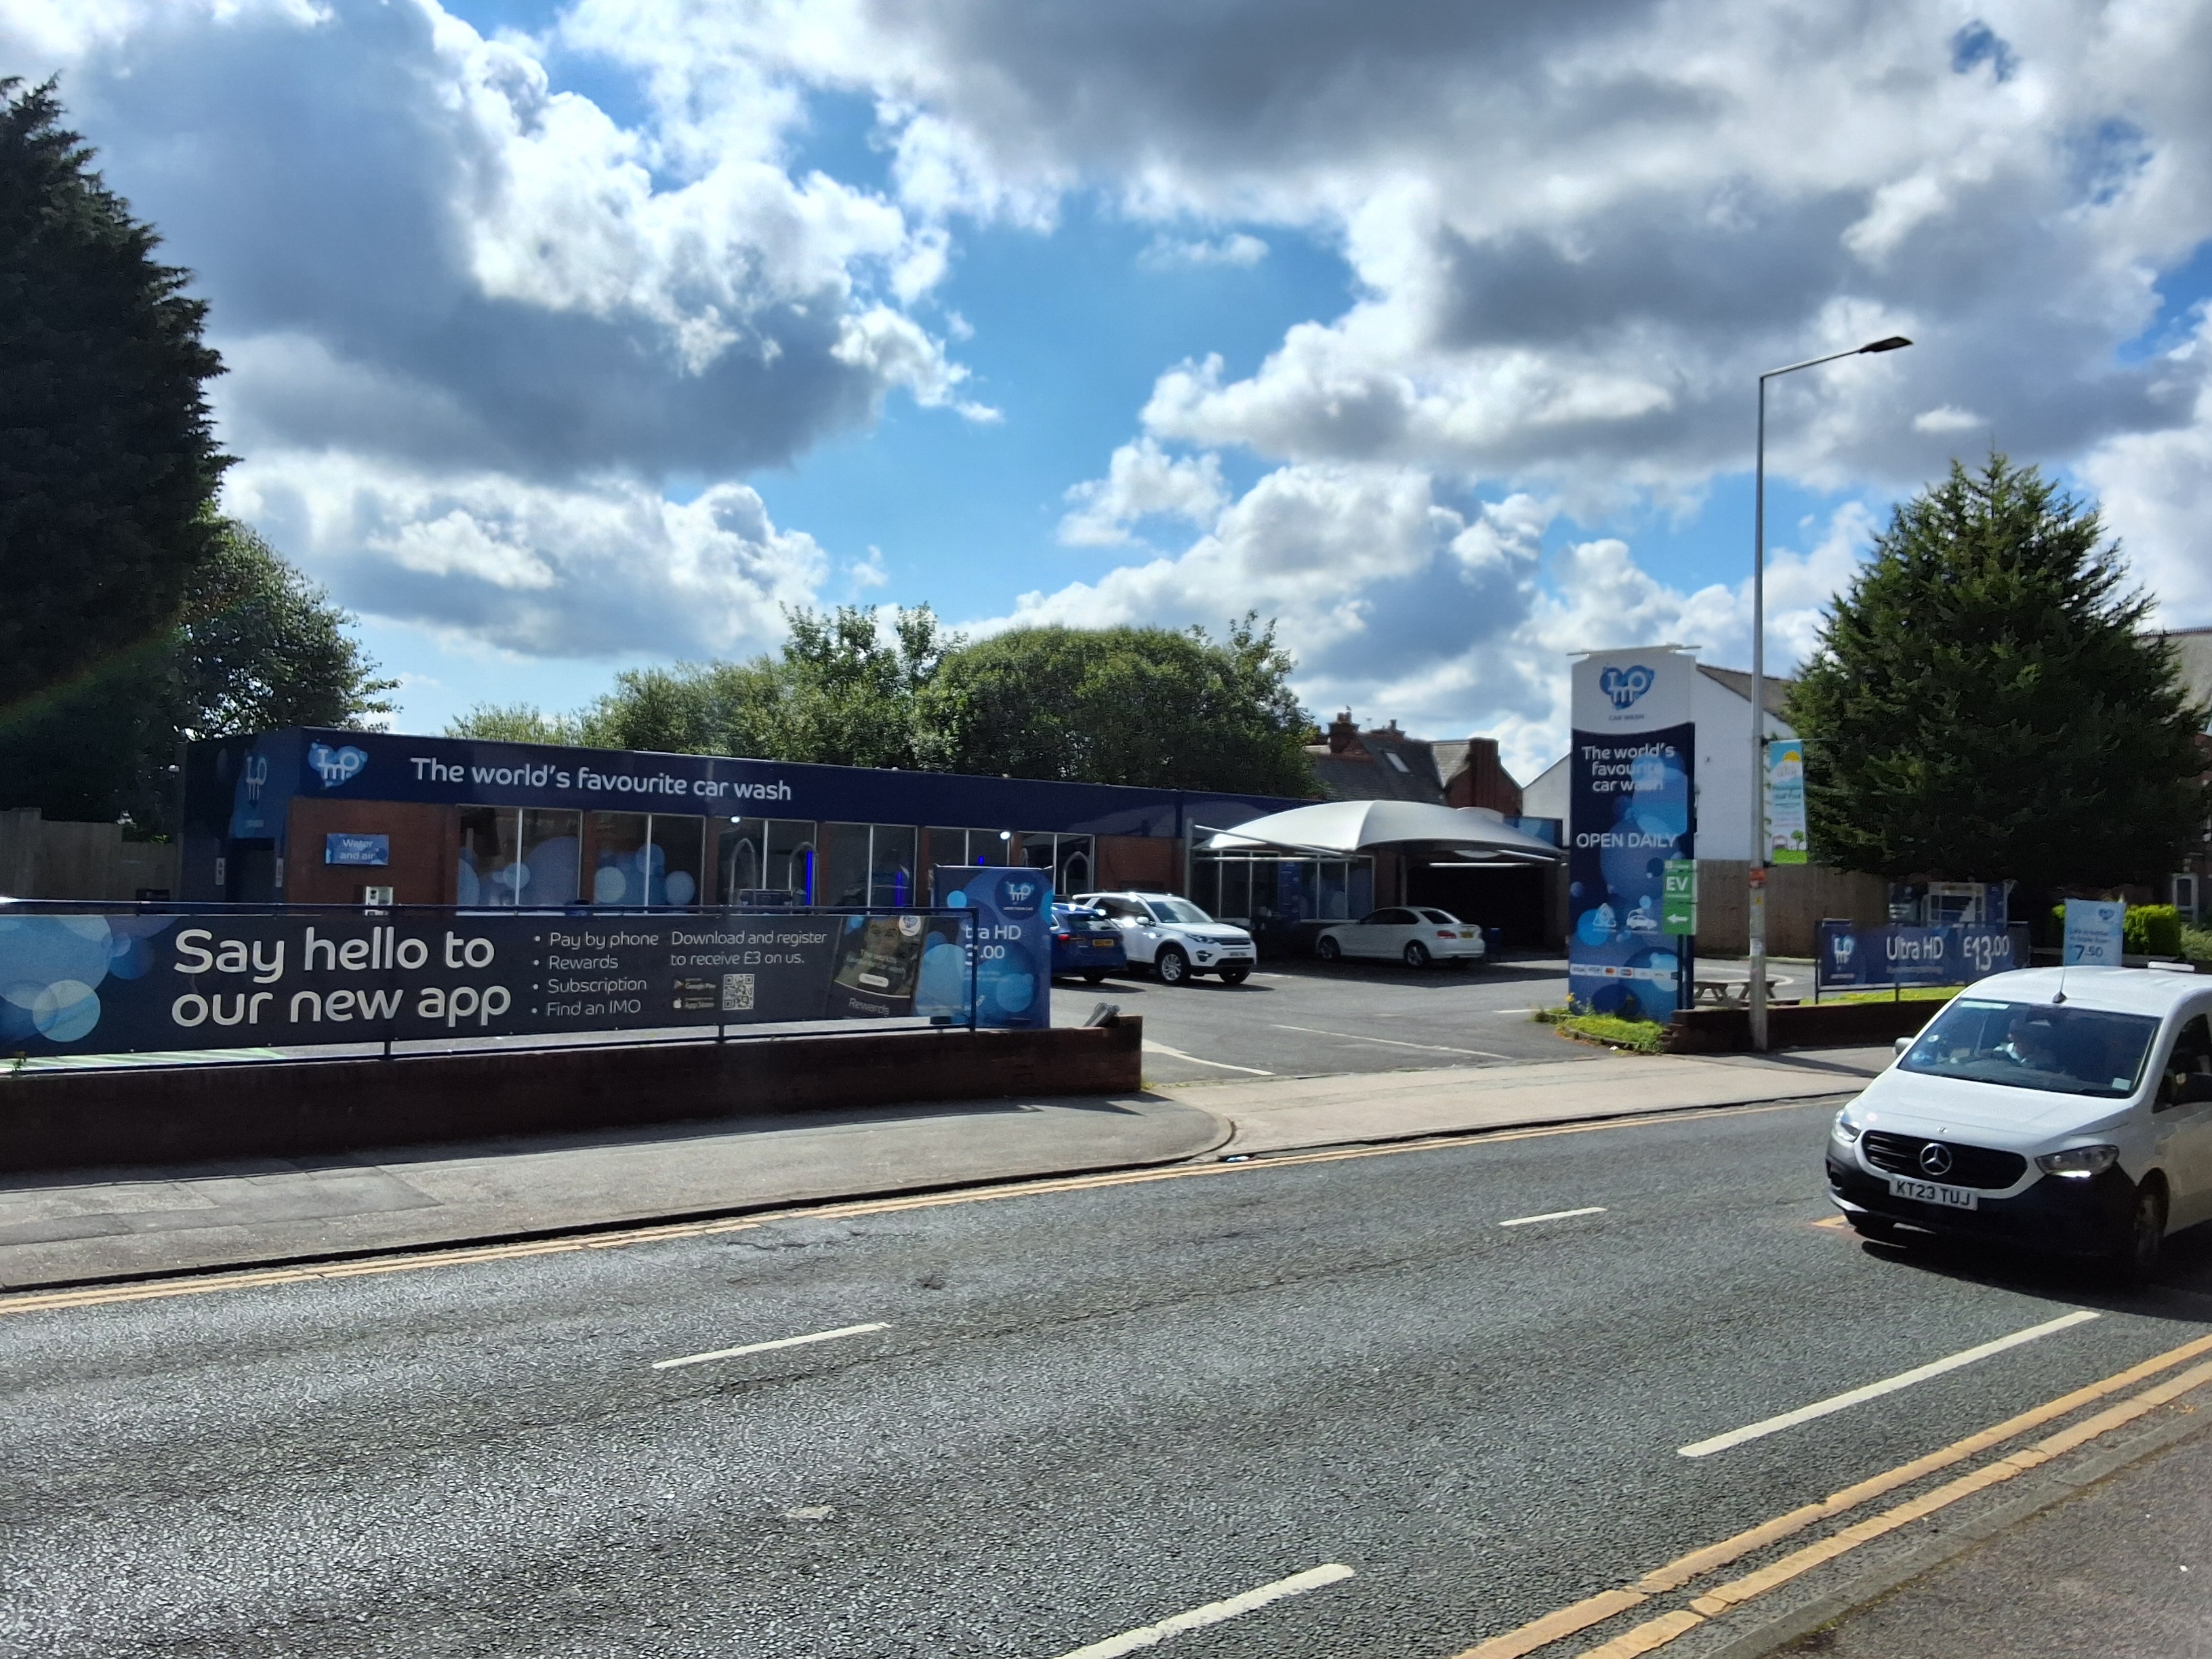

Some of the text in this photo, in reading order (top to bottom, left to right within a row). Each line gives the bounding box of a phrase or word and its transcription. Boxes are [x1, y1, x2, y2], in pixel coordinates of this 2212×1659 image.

[1581, 742, 1675, 760] The world's
[410, 757, 792, 801] The world's favourite car wash
[1592, 780, 1618, 792] car
[342, 838, 373, 848] Water
[1576, 832, 1678, 848] OPEN DAILY
[340, 851, 374, 860] and air
[1666, 876, 1689, 891] EV
[550, 931, 659, 950] Pay by phone
[672, 930, 827, 947] Download and register
[994, 924, 1022, 941] HD
[173, 926, 495, 984] Say hello to
[1923, 936, 1944, 960] HD
[549, 954, 619, 970] Rewards
[671, 951, 805, 966] to receive £3 on us.
[548, 977, 647, 994] Subscription
[171, 985, 512, 1027] our new app
[546, 999, 641, 1017] Find an IMO
[848, 997, 890, 1015] Rewards
[1897, 1180, 1971, 1206] KT23 TUJ
